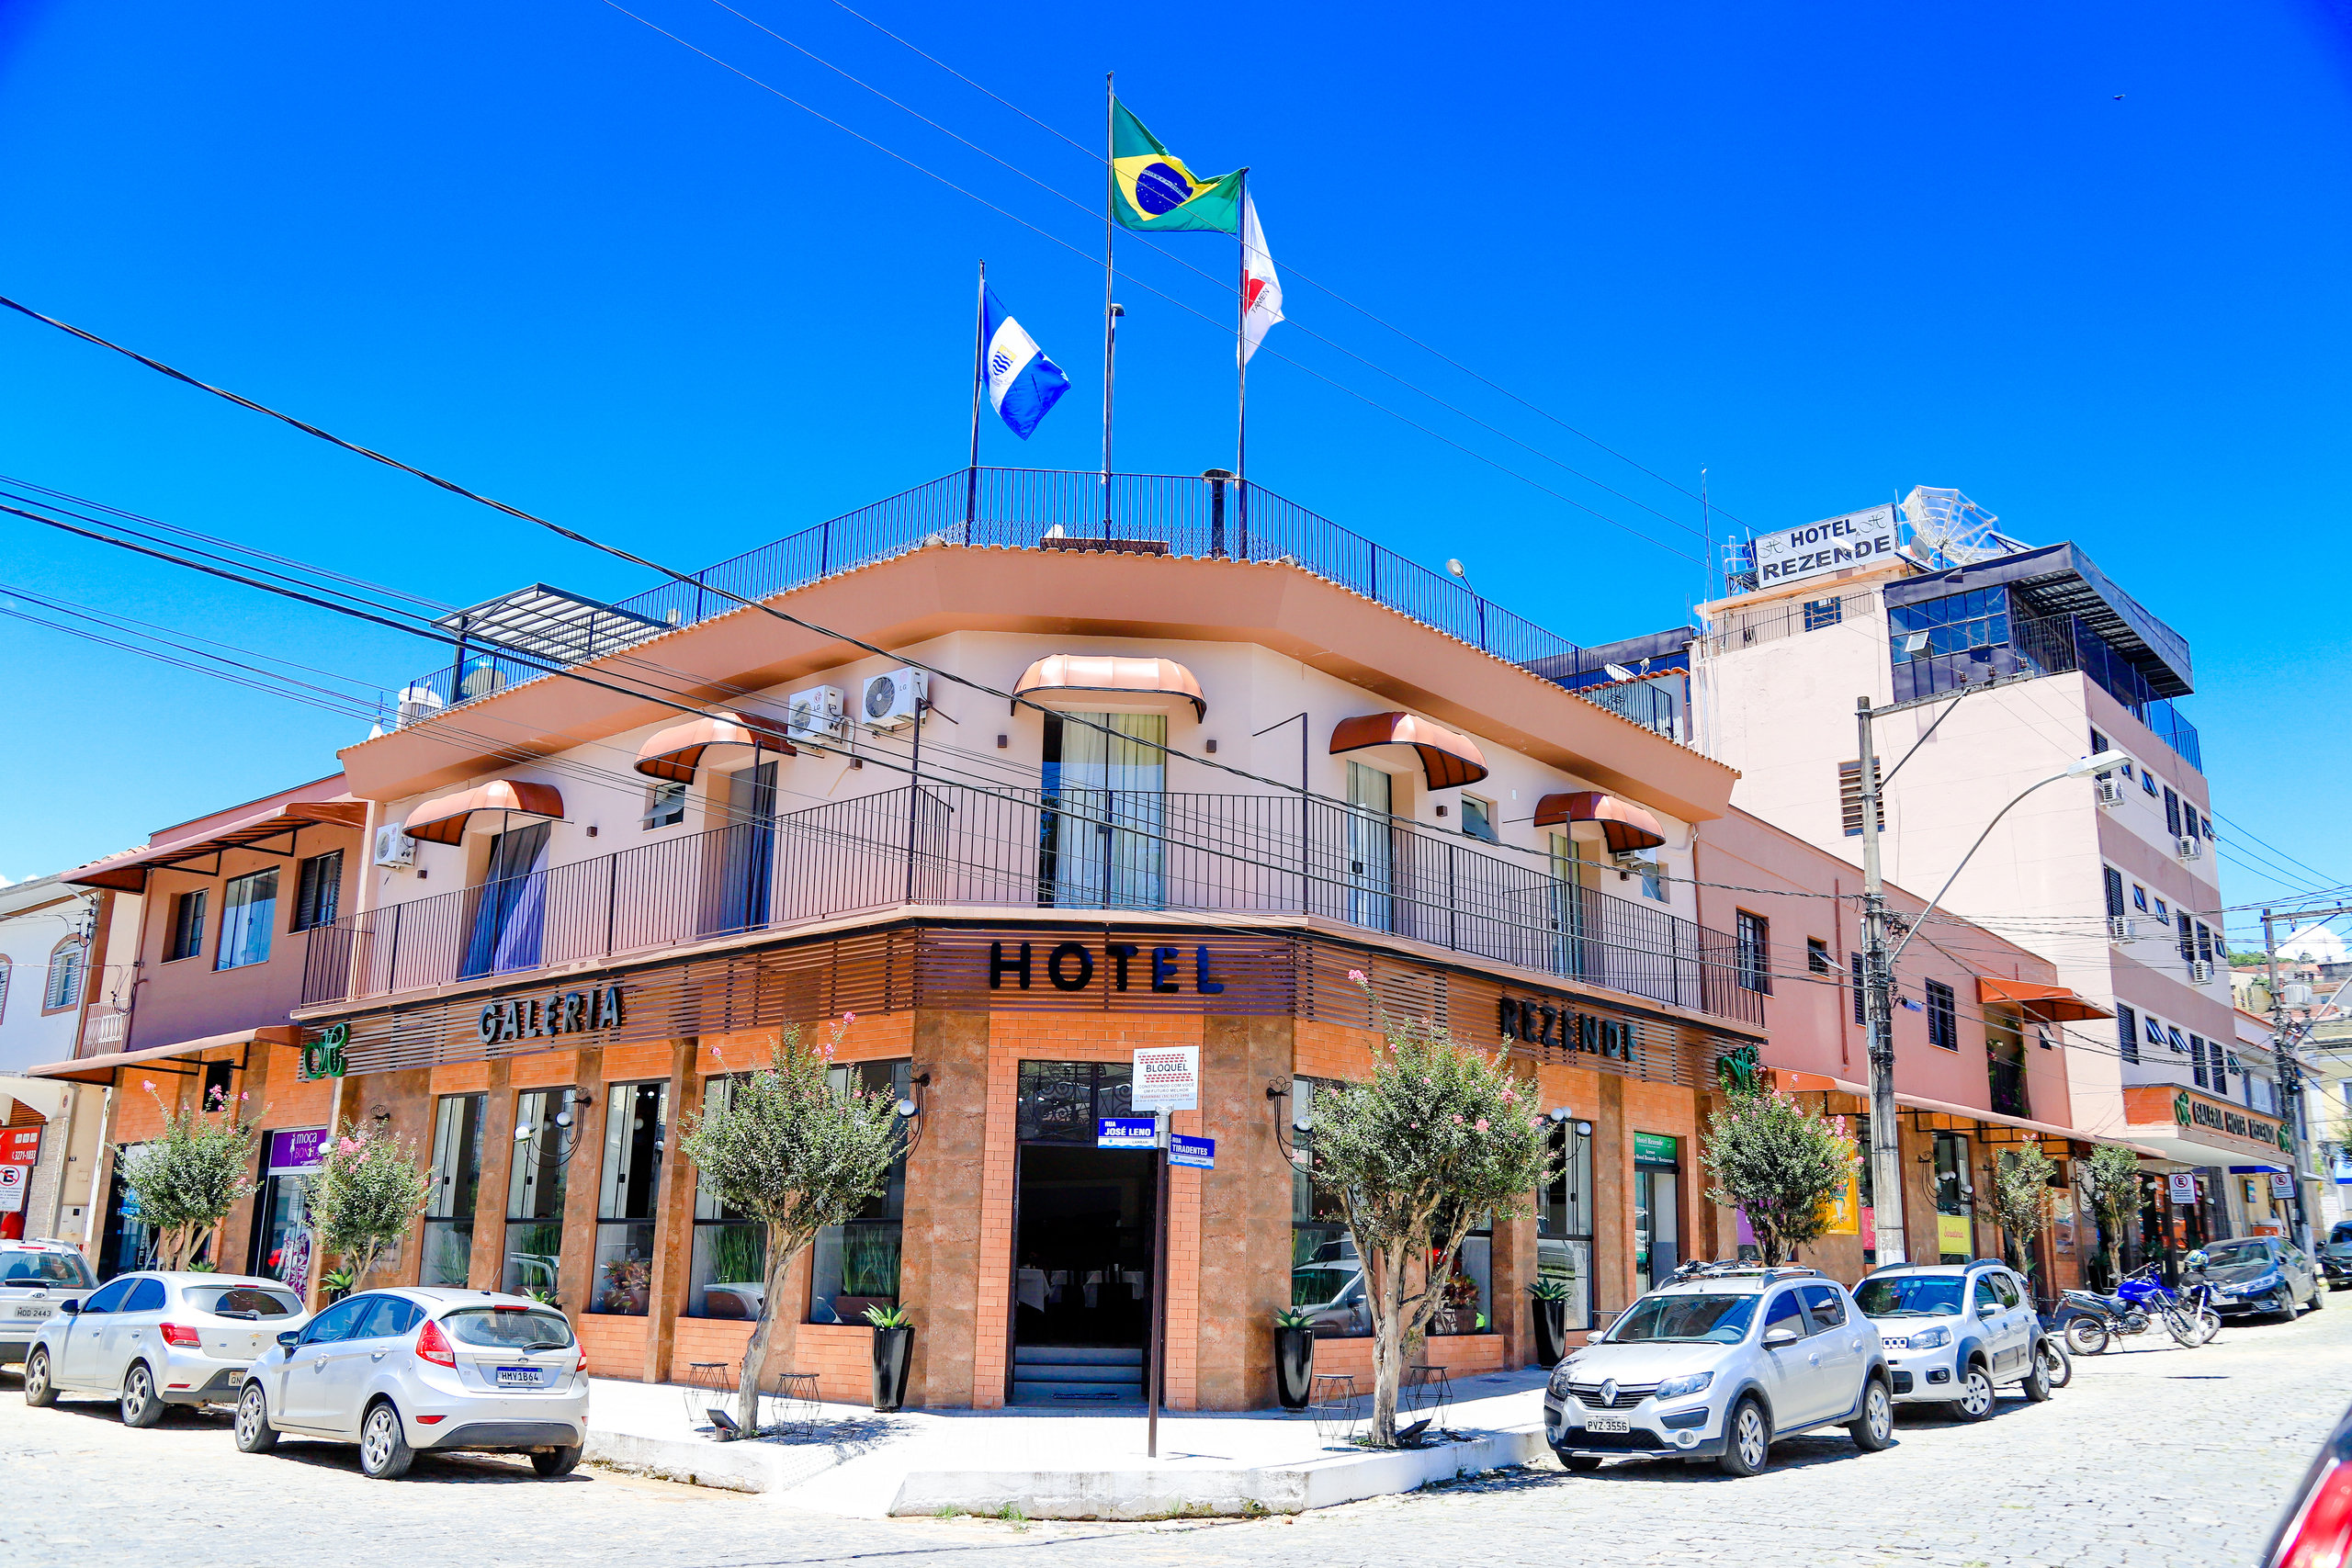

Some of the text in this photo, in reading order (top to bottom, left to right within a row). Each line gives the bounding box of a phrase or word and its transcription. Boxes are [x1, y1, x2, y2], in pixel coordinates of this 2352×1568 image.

[1250, 288, 1270, 313] TAMEN
[1791, 518, 1857, 548] HOTEL
[1762, 535, 1892, 581] REZENDE
[989, 941, 1225, 994] HOTEL
[477, 986, 626, 1043] GALERIA
[1499, 998, 1638, 1061] REZENDE
[1146, 1063, 1189, 1073] BLOQUEL
[2192, 1101, 2224, 1131] GALERIA
[296, 1132, 318, 1146] moça
[1104, 1126, 1151, 1136] JOSÉ LENO
[1171, 1144, 1208, 1156] TIRADENTES
[502, 1371, 538, 1382] HMY1B64
